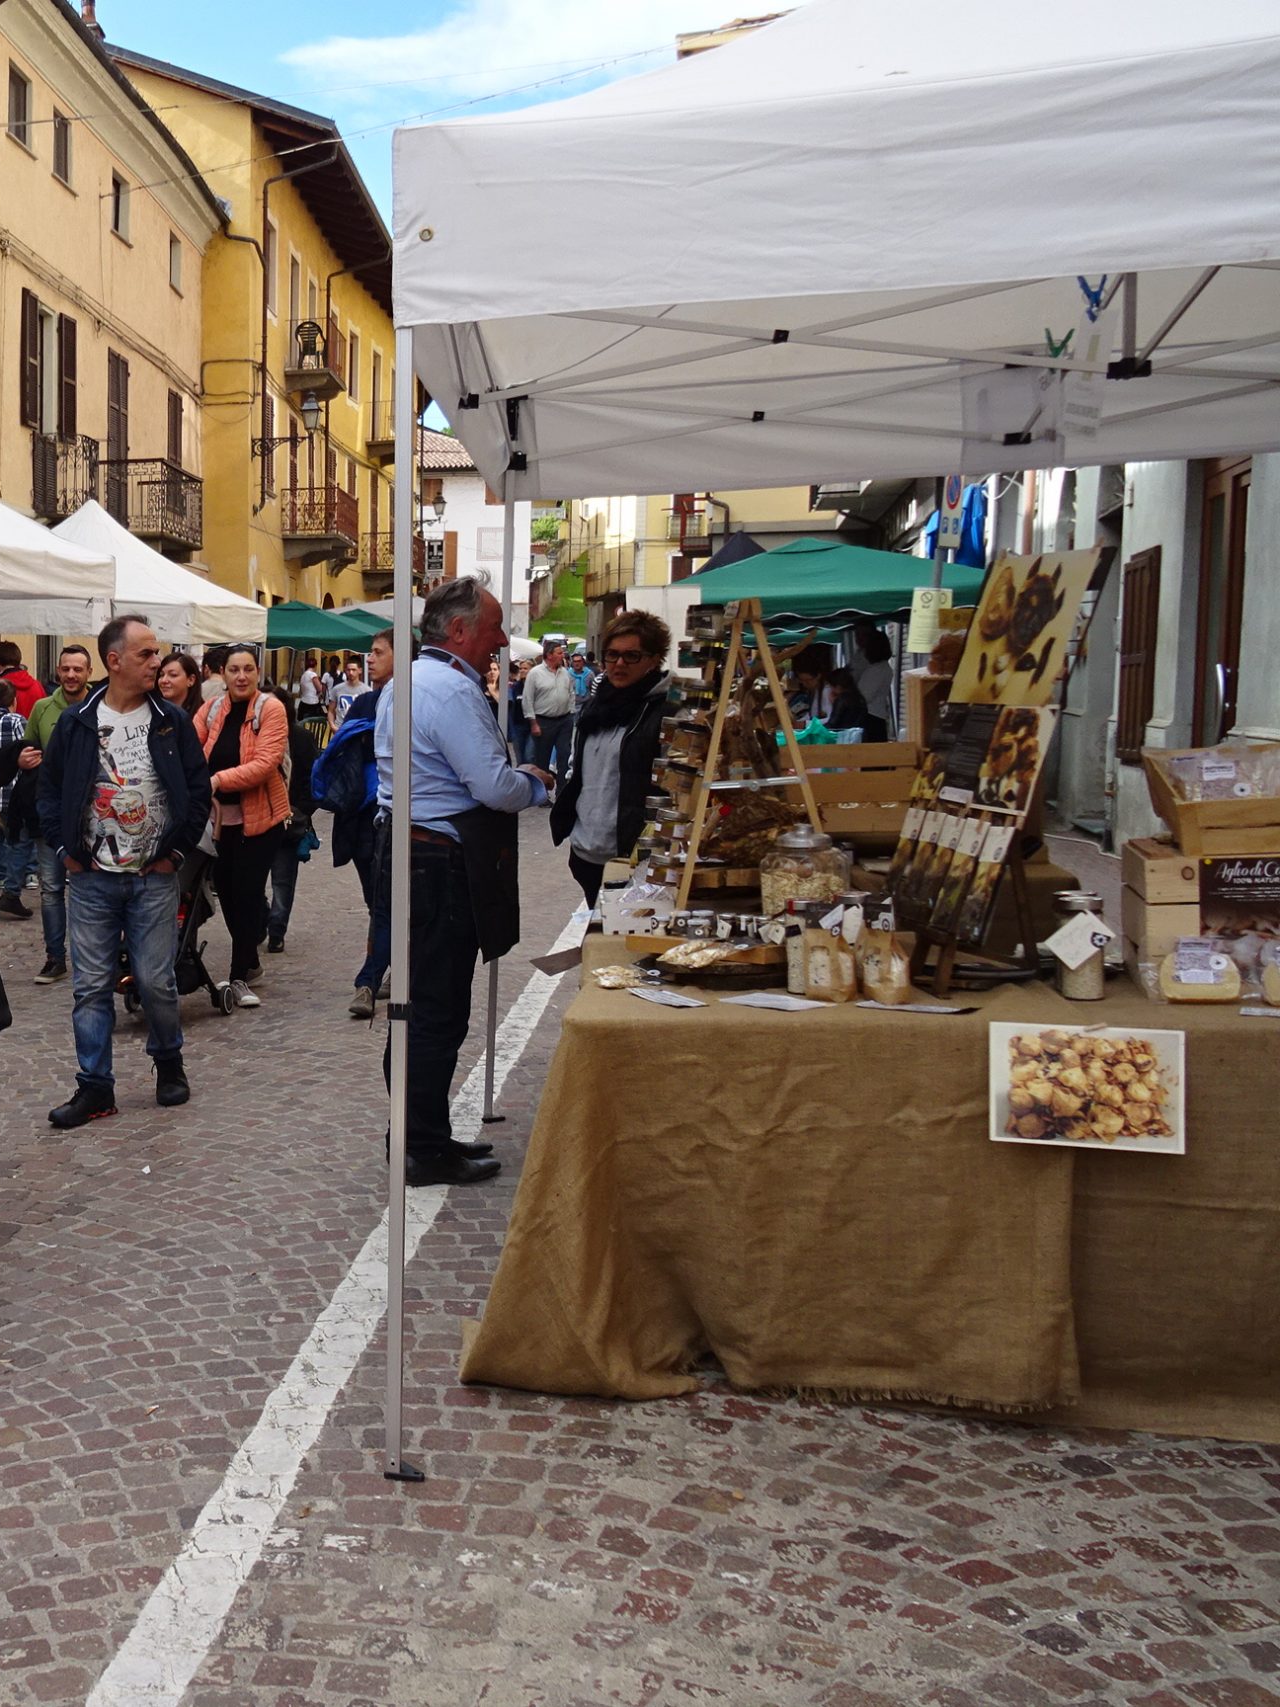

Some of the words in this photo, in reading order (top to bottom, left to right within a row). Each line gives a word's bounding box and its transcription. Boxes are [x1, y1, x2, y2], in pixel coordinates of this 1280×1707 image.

[1214, 860, 1249, 882] Aglio
[1249, 859, 1264, 877] di
[1264, 860, 1280, 877] Ca
[1254, 876, 1280, 884] NATUR
